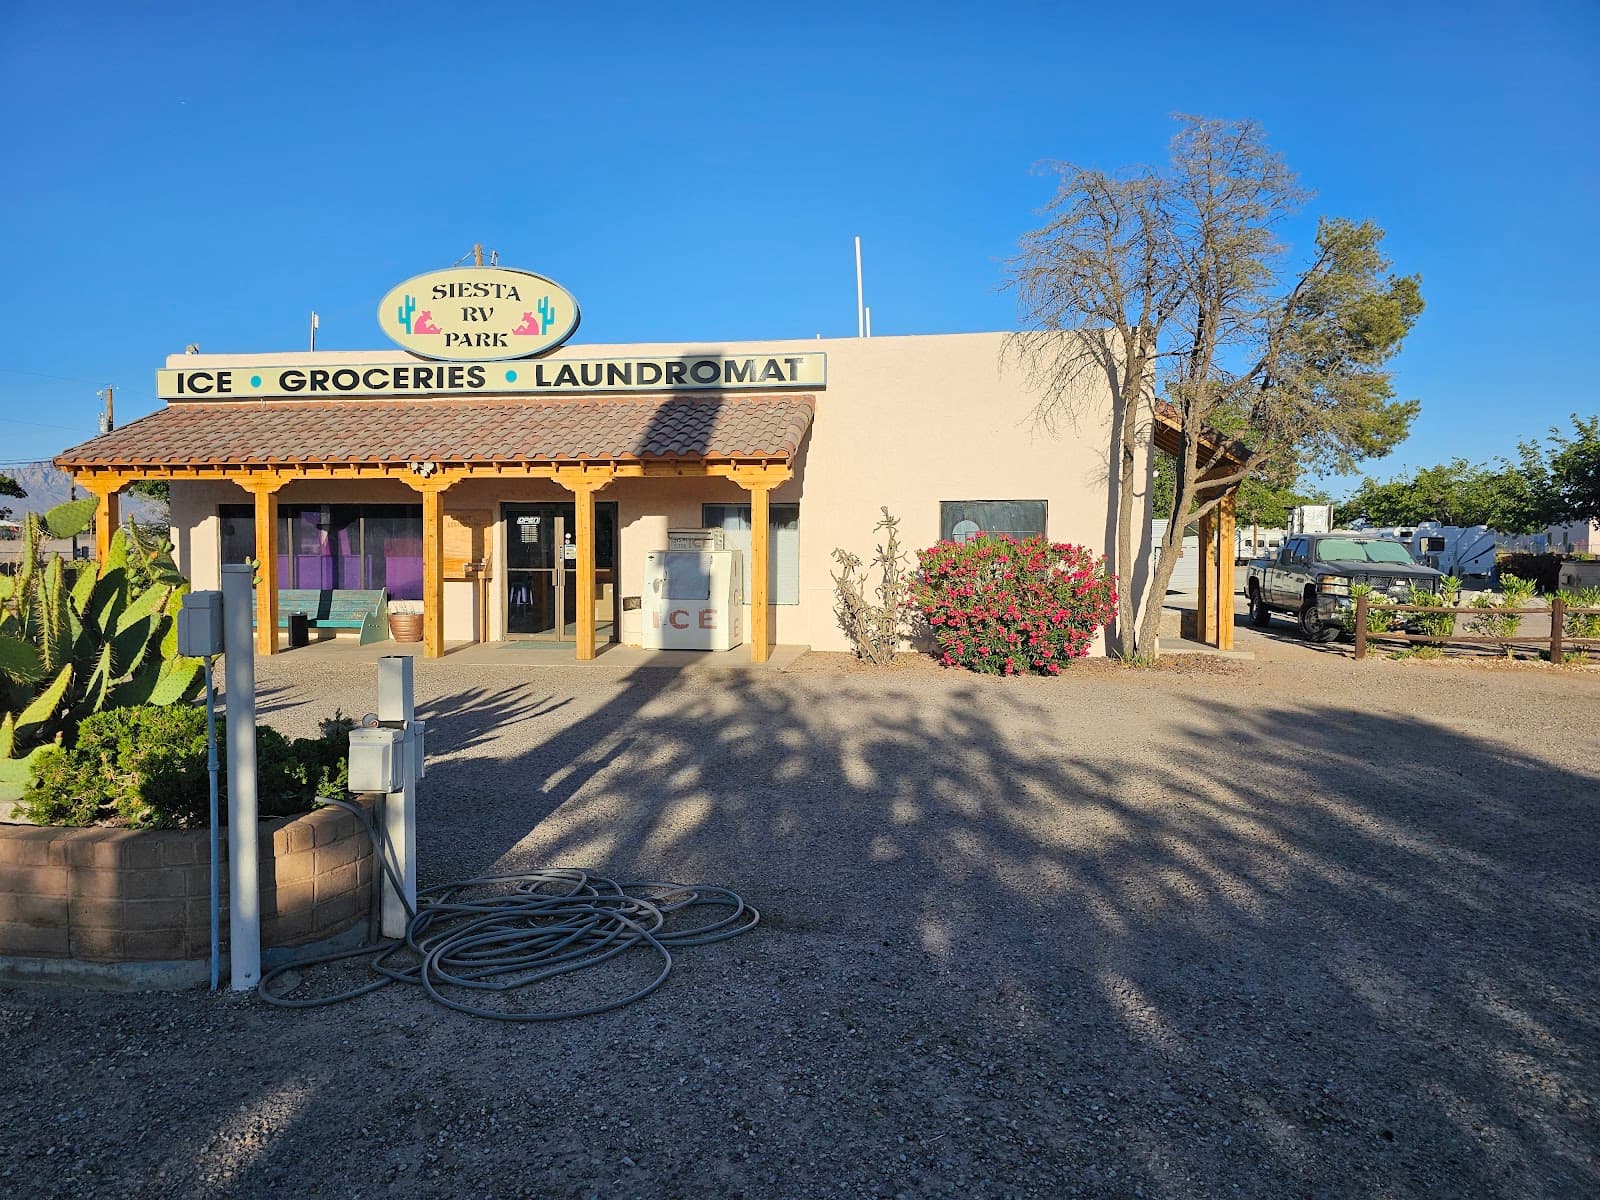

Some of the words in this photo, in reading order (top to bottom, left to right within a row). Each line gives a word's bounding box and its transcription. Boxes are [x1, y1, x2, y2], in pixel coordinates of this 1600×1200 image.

[432, 282, 521, 301] SIESTA
[461, 306, 494, 322] RV
[444, 332, 508, 347] PARK
[177, 371, 232, 393] ICE
[279, 365, 486, 392] GROCERIES
[535, 357, 804, 387] LAUNDROMAT
[652, 608, 718, 630] ICE
